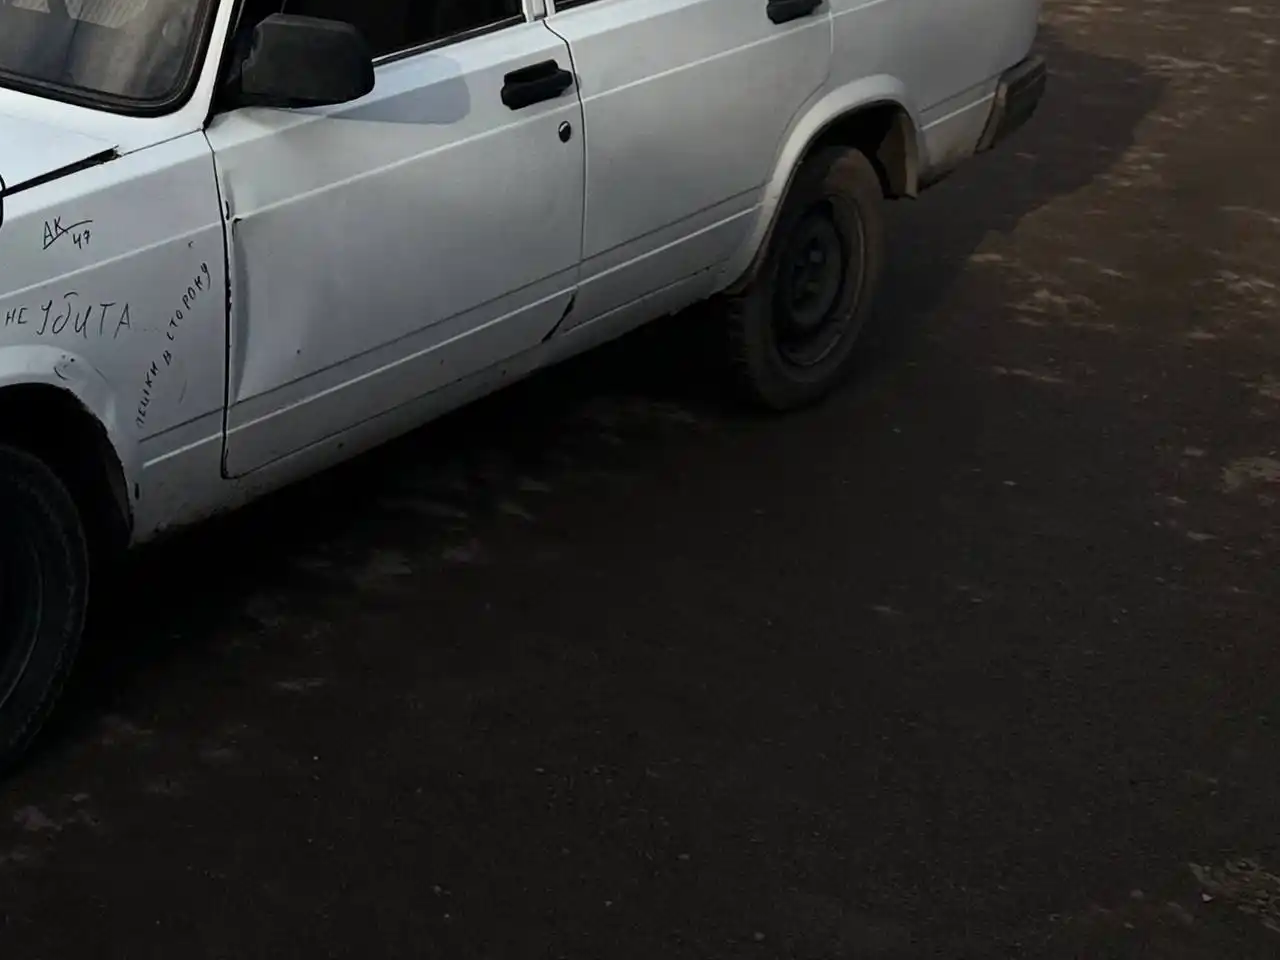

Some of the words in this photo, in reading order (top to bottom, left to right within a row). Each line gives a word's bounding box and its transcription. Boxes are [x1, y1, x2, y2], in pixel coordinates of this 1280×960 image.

[42, 215, 70, 250] АК
[72, 229, 91, 250] 47
[166, 262, 211, 342] СТОРОНУ
[4, 304, 29, 328] НЕ
[162, 349, 173, 367] В
